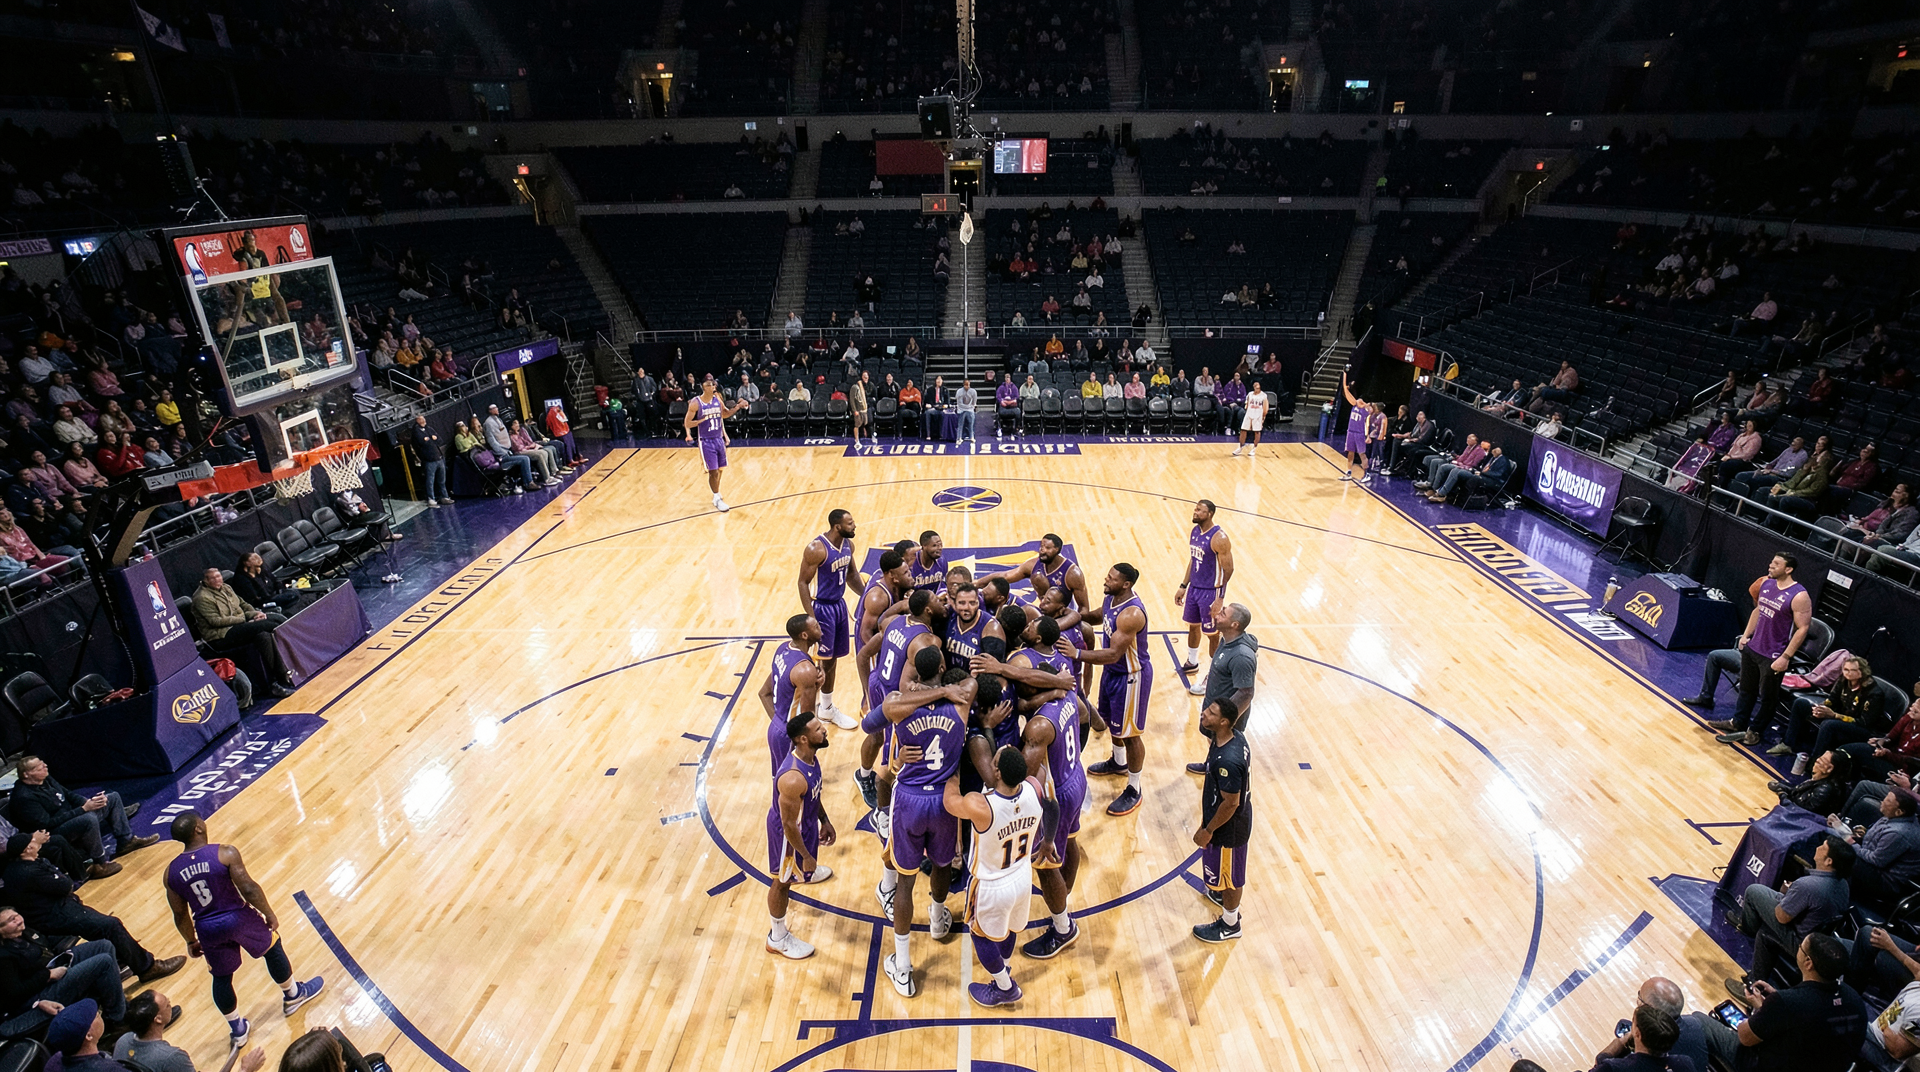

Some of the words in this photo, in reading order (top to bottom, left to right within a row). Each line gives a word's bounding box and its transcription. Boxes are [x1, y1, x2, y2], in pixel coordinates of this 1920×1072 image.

[882, 648, 895, 681] 9
[924, 734, 945, 771] 4
[1001, 832, 1029, 870] 13
